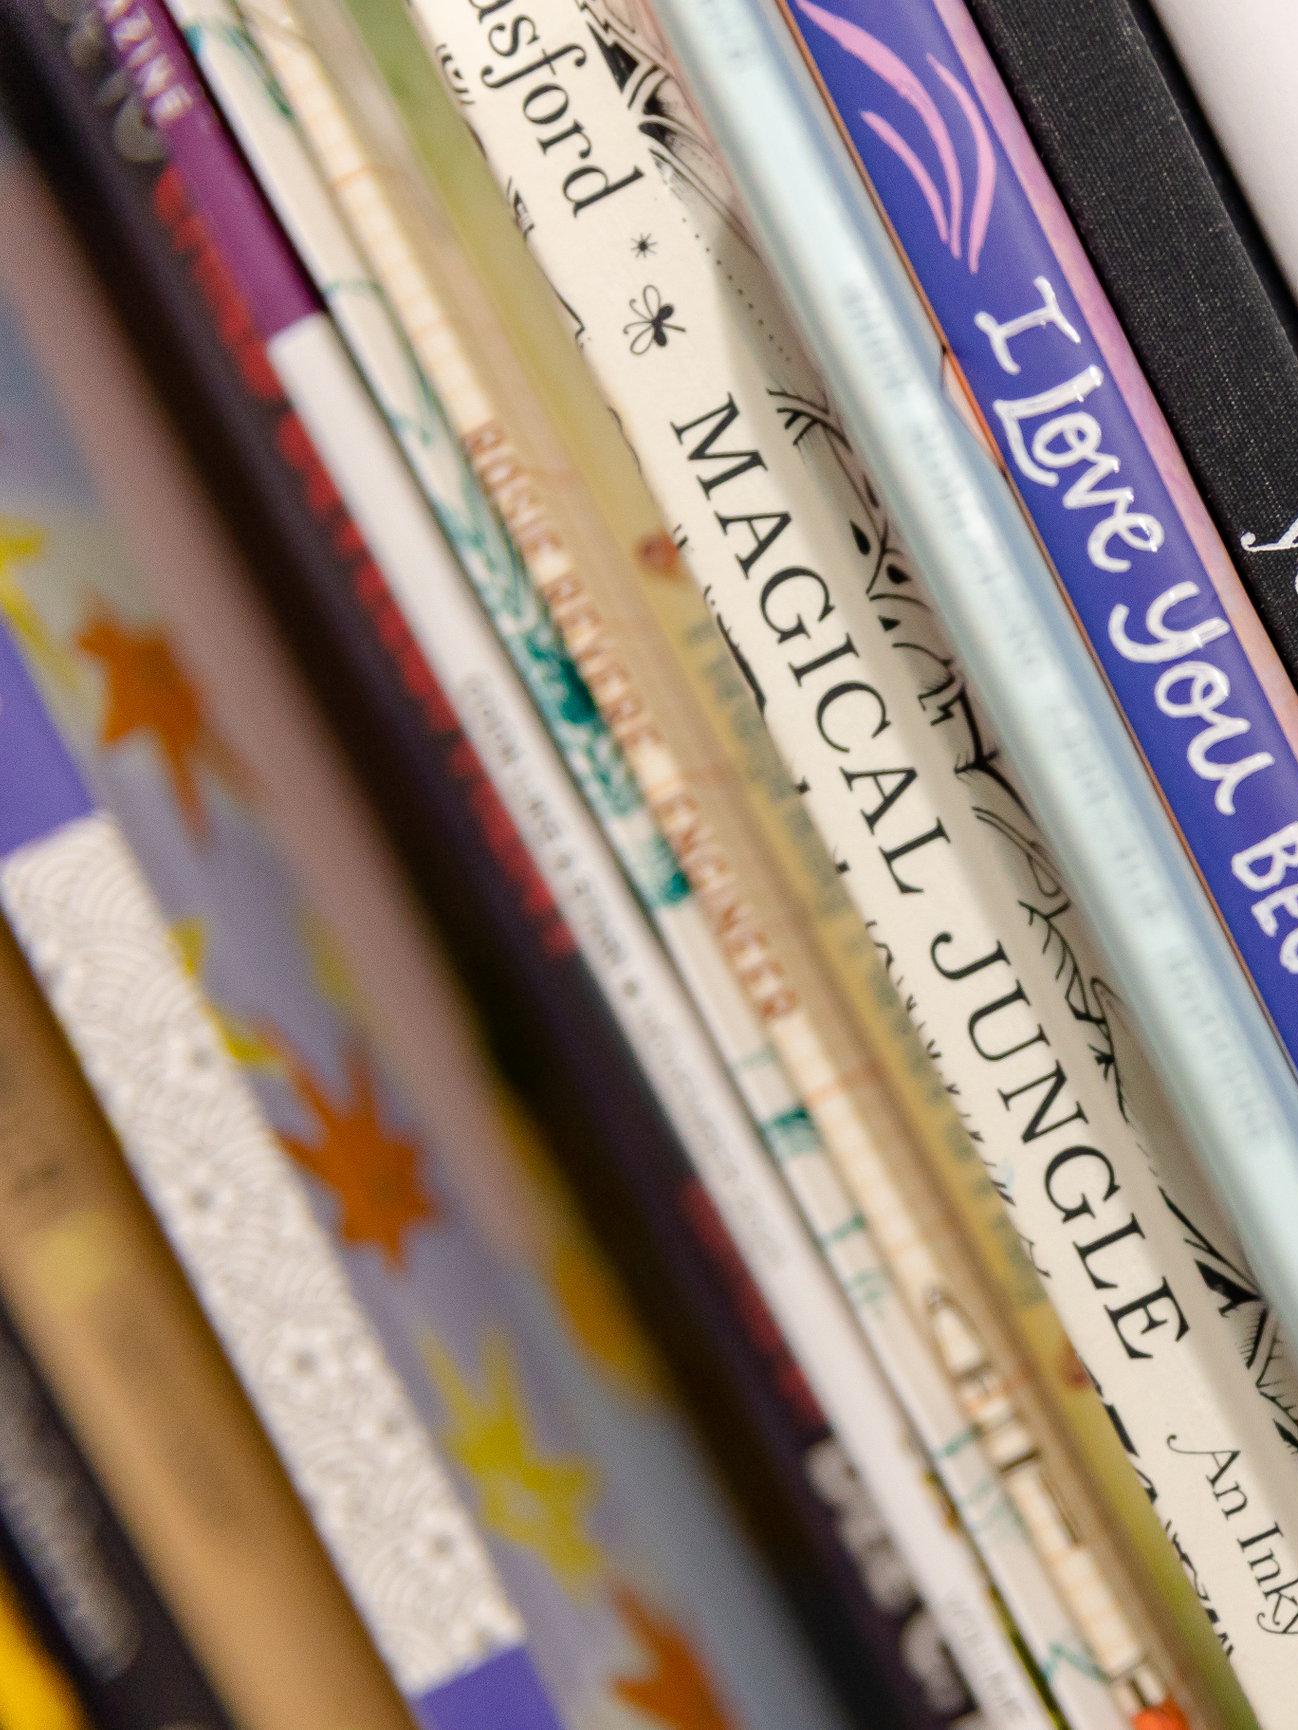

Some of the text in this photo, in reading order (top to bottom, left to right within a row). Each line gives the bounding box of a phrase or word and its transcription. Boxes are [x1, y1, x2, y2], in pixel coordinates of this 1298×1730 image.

[974, 276, 1081, 374] I
[670, 392, 951, 895] MAGICAL
[930, 931, 1189, 1360] JUNGLE
[1166, 1434, 1248, 1521] An
